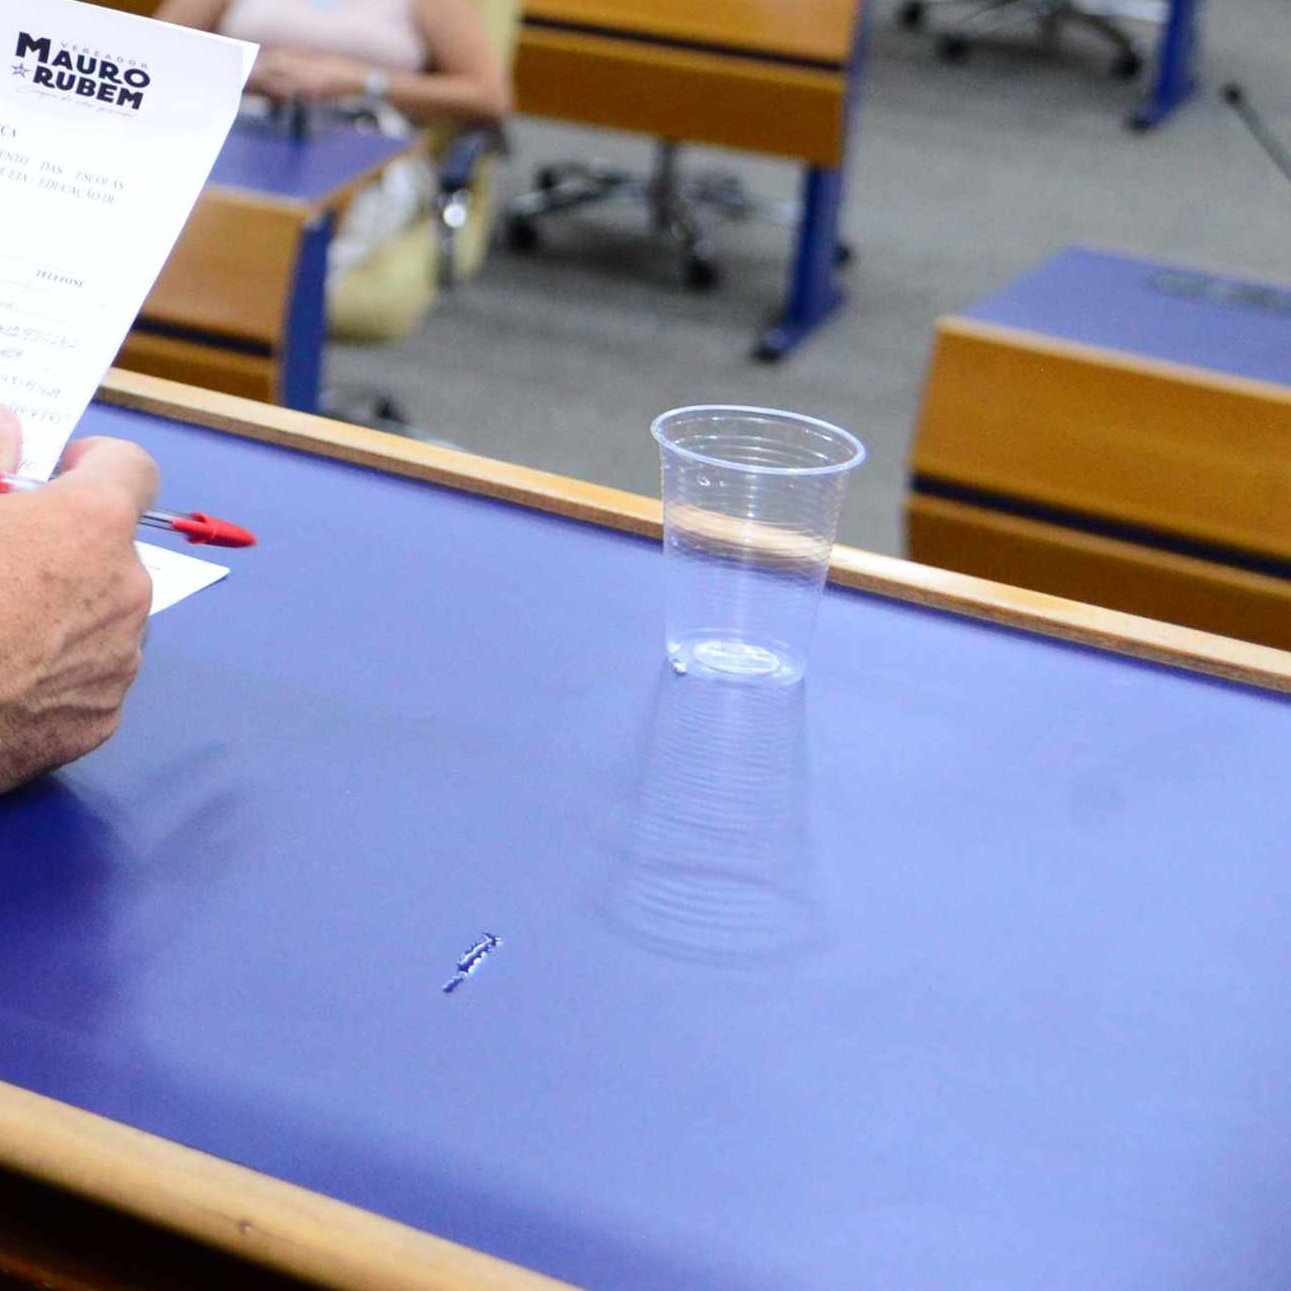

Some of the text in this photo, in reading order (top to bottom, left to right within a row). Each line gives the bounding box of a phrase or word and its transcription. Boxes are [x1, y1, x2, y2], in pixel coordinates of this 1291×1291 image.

[14, 31, 151, 89] MAURO
[60, 42, 148, 70] VEREADOR
[32, 65, 144, 111] RUBEM
[8, 168, 28, 184] EJA
[39, 177, 101, 203] EDUCAÇÃO
[102, 194, 118, 206] DE
[39, 160, 65, 176] DAS
[75, 170, 125, 192] ESCOLAS
[35, 268, 87, 290] TELEFONE
